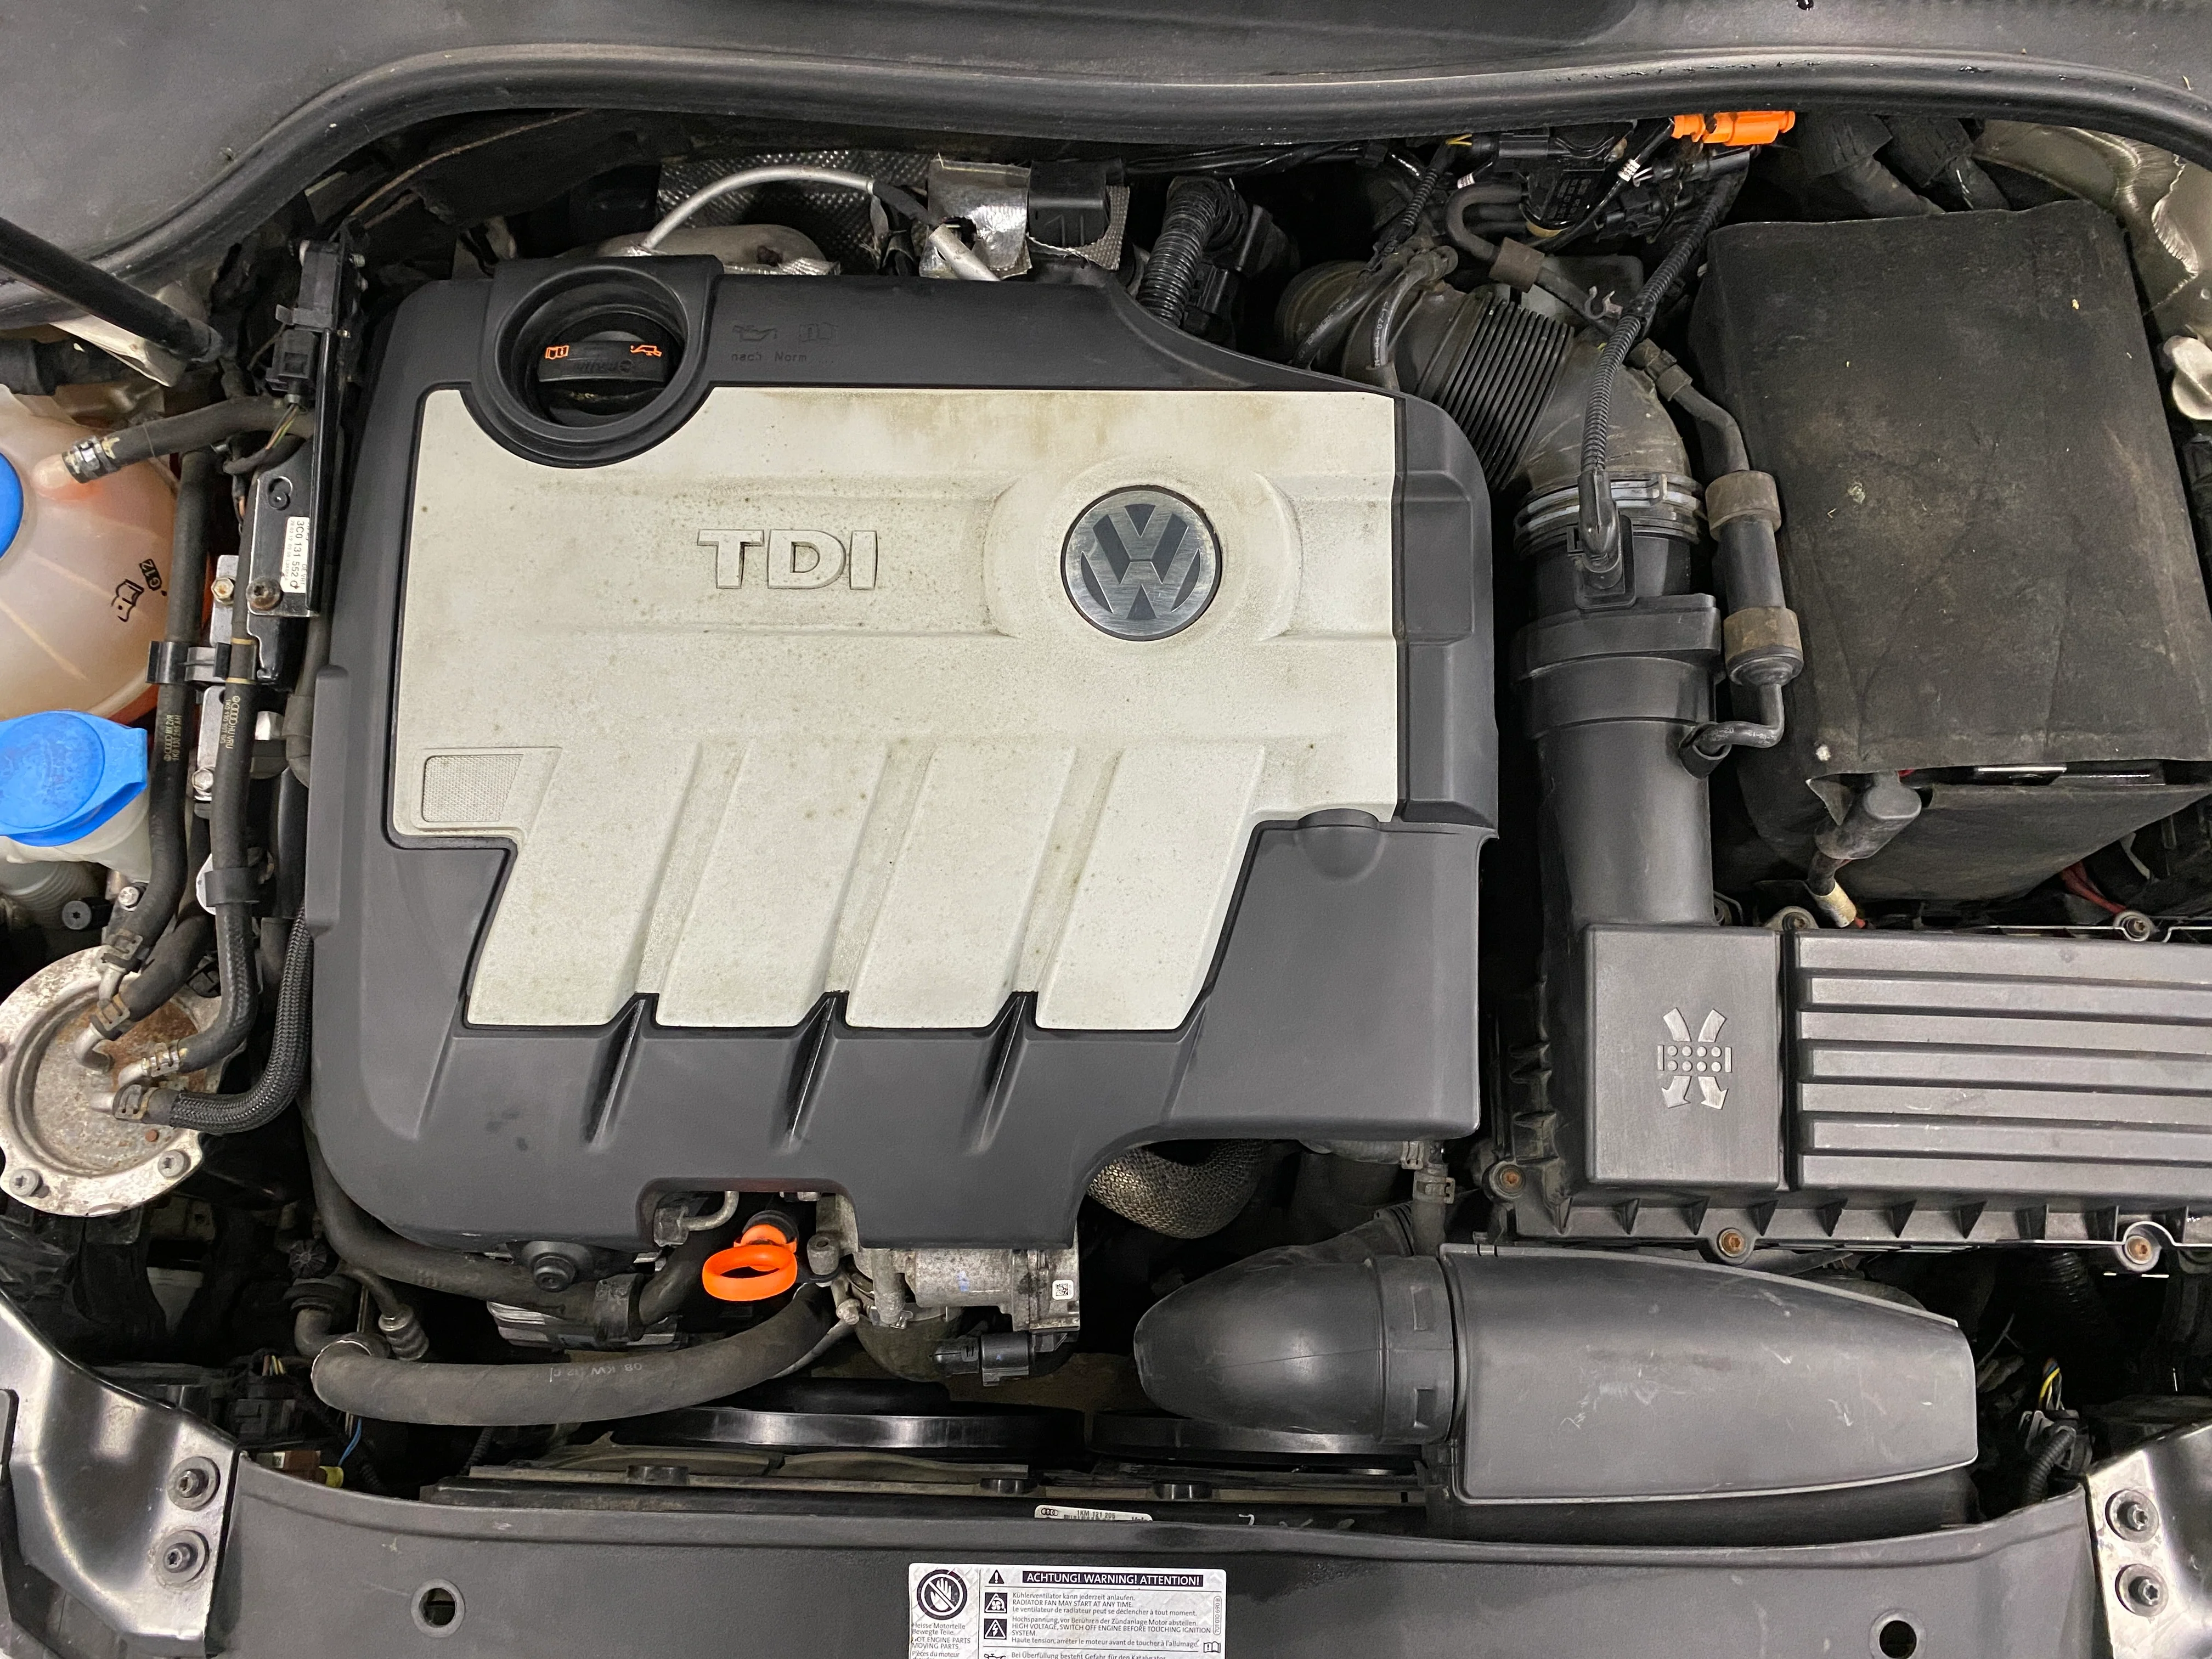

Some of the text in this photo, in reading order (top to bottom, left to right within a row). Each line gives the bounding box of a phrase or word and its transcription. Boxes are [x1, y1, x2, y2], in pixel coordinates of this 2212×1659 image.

[774, 352, 807, 362] Norm
[295, 521, 305, 539] 3C0
[293, 542, 302, 557] 131
[697, 528, 878, 590] TDI
[141, 560, 162, 589] G12
[291, 561, 300, 577] 552
[1026, 1572, 1199, 1585] ACHTUNG! WARNING! ATTENTION!
